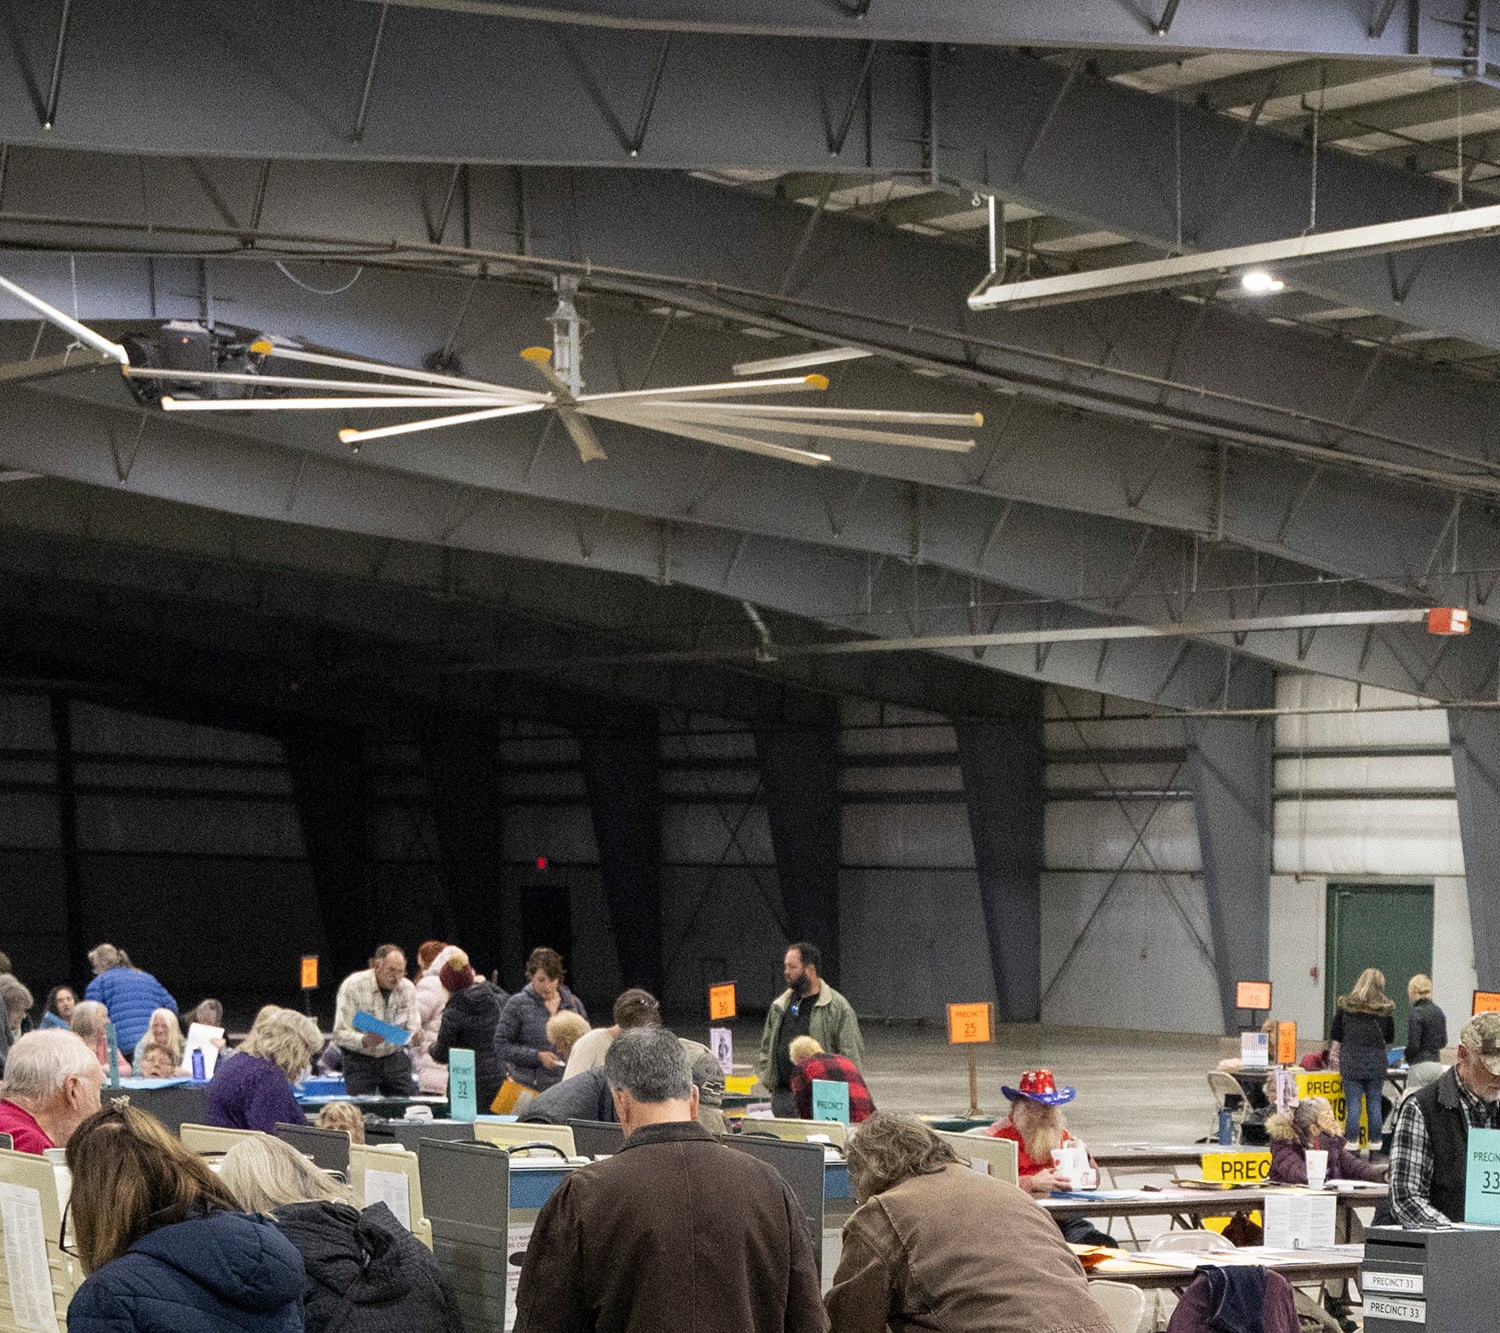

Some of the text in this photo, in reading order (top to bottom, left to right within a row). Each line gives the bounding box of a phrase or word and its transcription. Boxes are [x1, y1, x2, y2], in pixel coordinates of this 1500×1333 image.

[964, 1022, 977, 1034] 25
[817, 1101, 844, 1110] PRECINCT
[1221, 1160, 1271, 1180] PREC
[1483, 1171, 1500, 1189] 33
[1372, 1276, 1414, 1288] PRECINCT 33
[1370, 1303, 1419, 1318] PRECINCT 33
